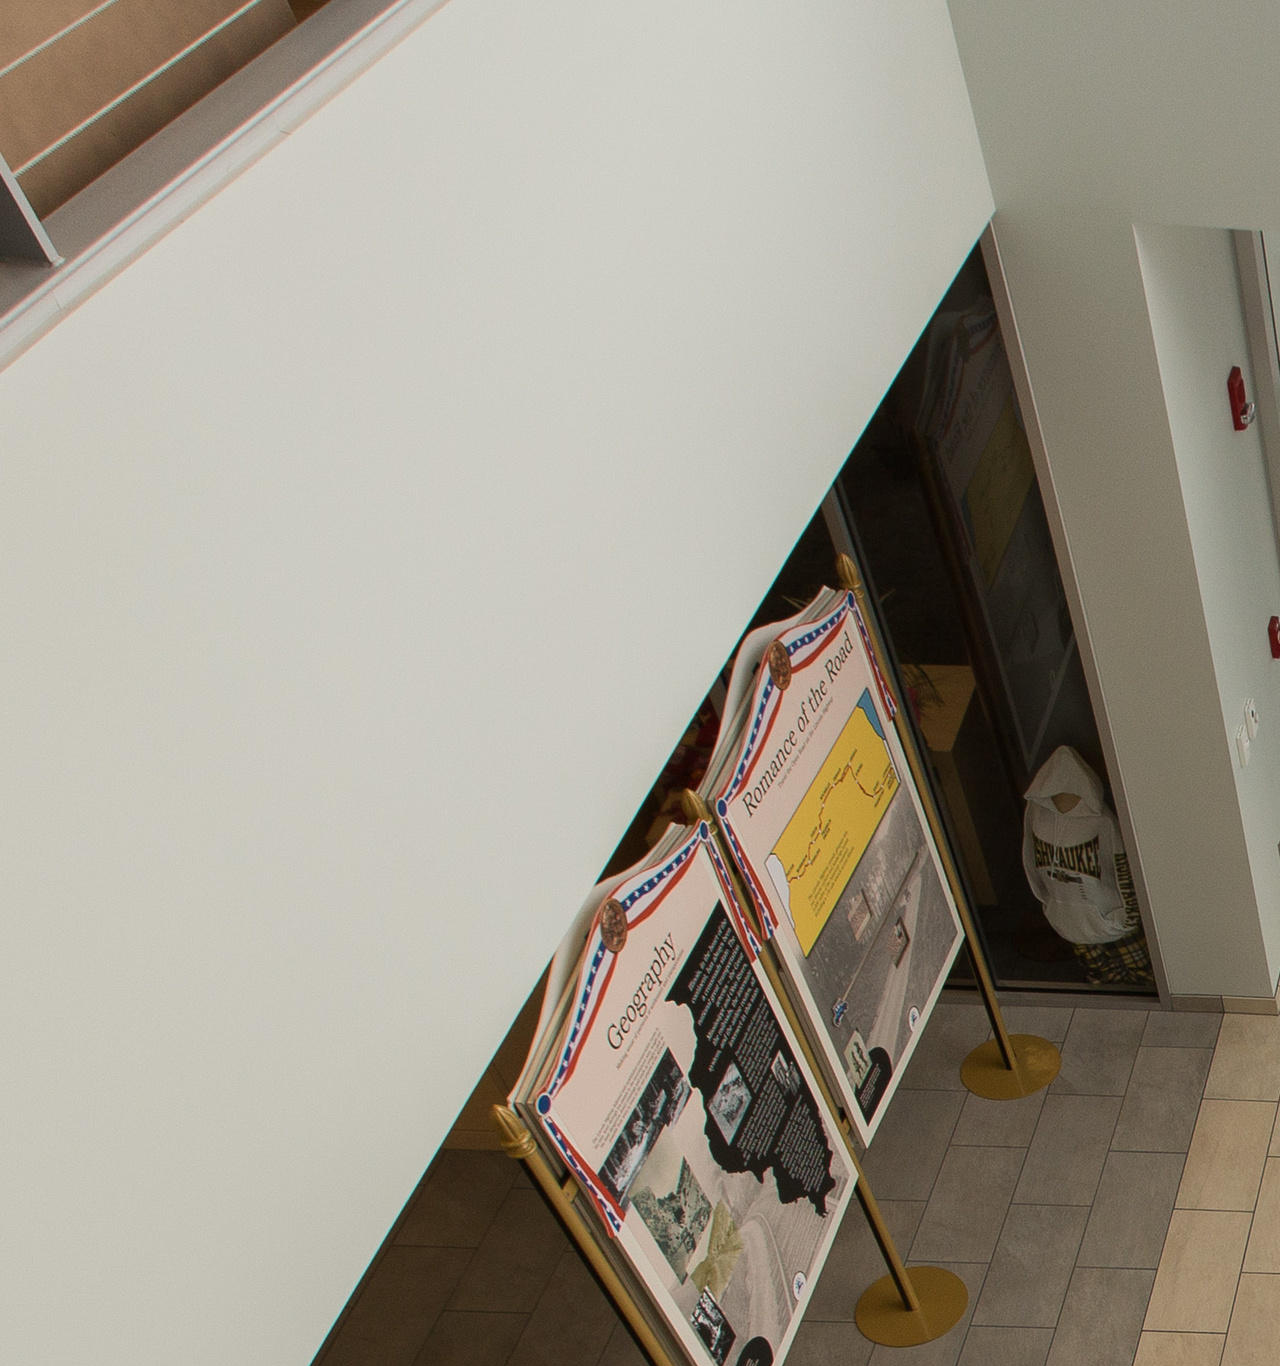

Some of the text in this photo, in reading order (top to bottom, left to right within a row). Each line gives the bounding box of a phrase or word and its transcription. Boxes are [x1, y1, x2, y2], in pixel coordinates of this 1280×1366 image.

[742, 630, 853, 817] Romance of the Road
[607, 933, 675, 1049] Geography
